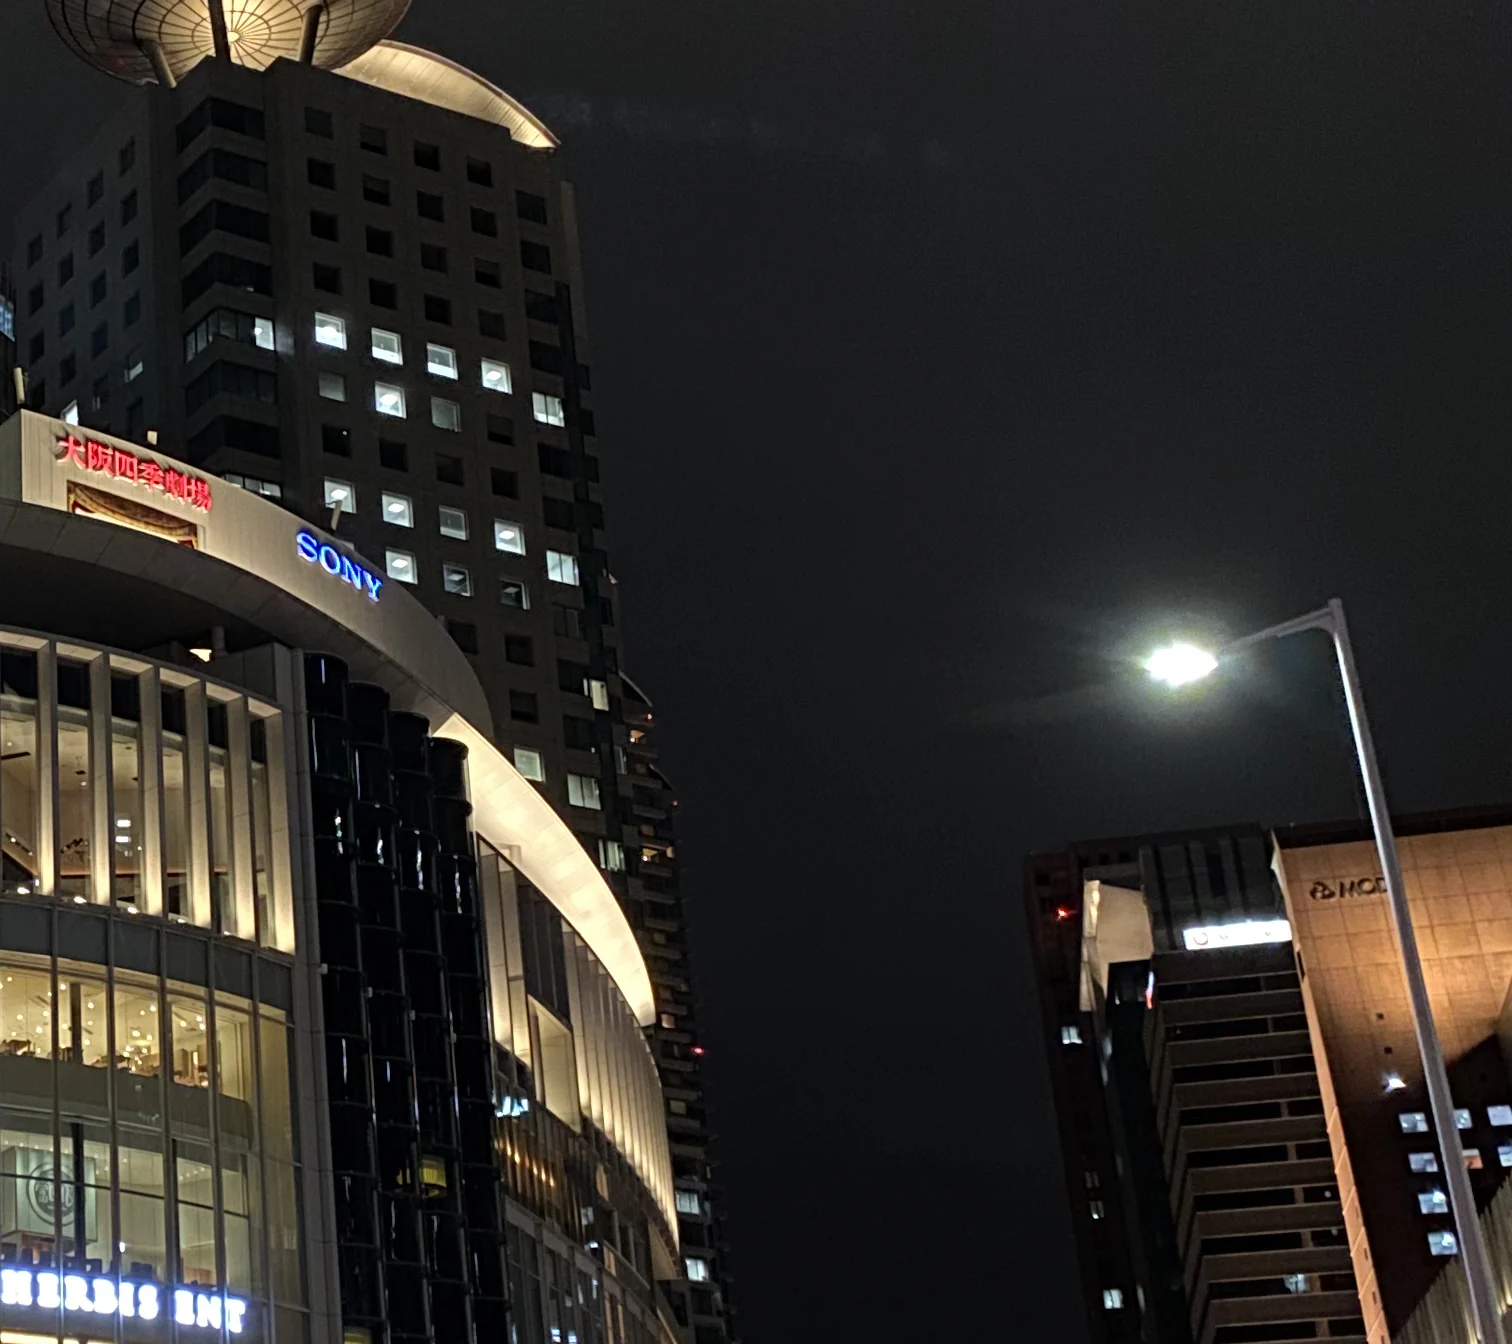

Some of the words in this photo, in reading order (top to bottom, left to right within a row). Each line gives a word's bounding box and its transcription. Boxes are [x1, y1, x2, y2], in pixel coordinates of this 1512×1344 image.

[57, 435, 213, 513] 大阪四季劇場
[296, 530, 383, 602] SONY
[0, 1267, 160, 1322] HERBIS
[174, 1289, 247, 1335] ENT
